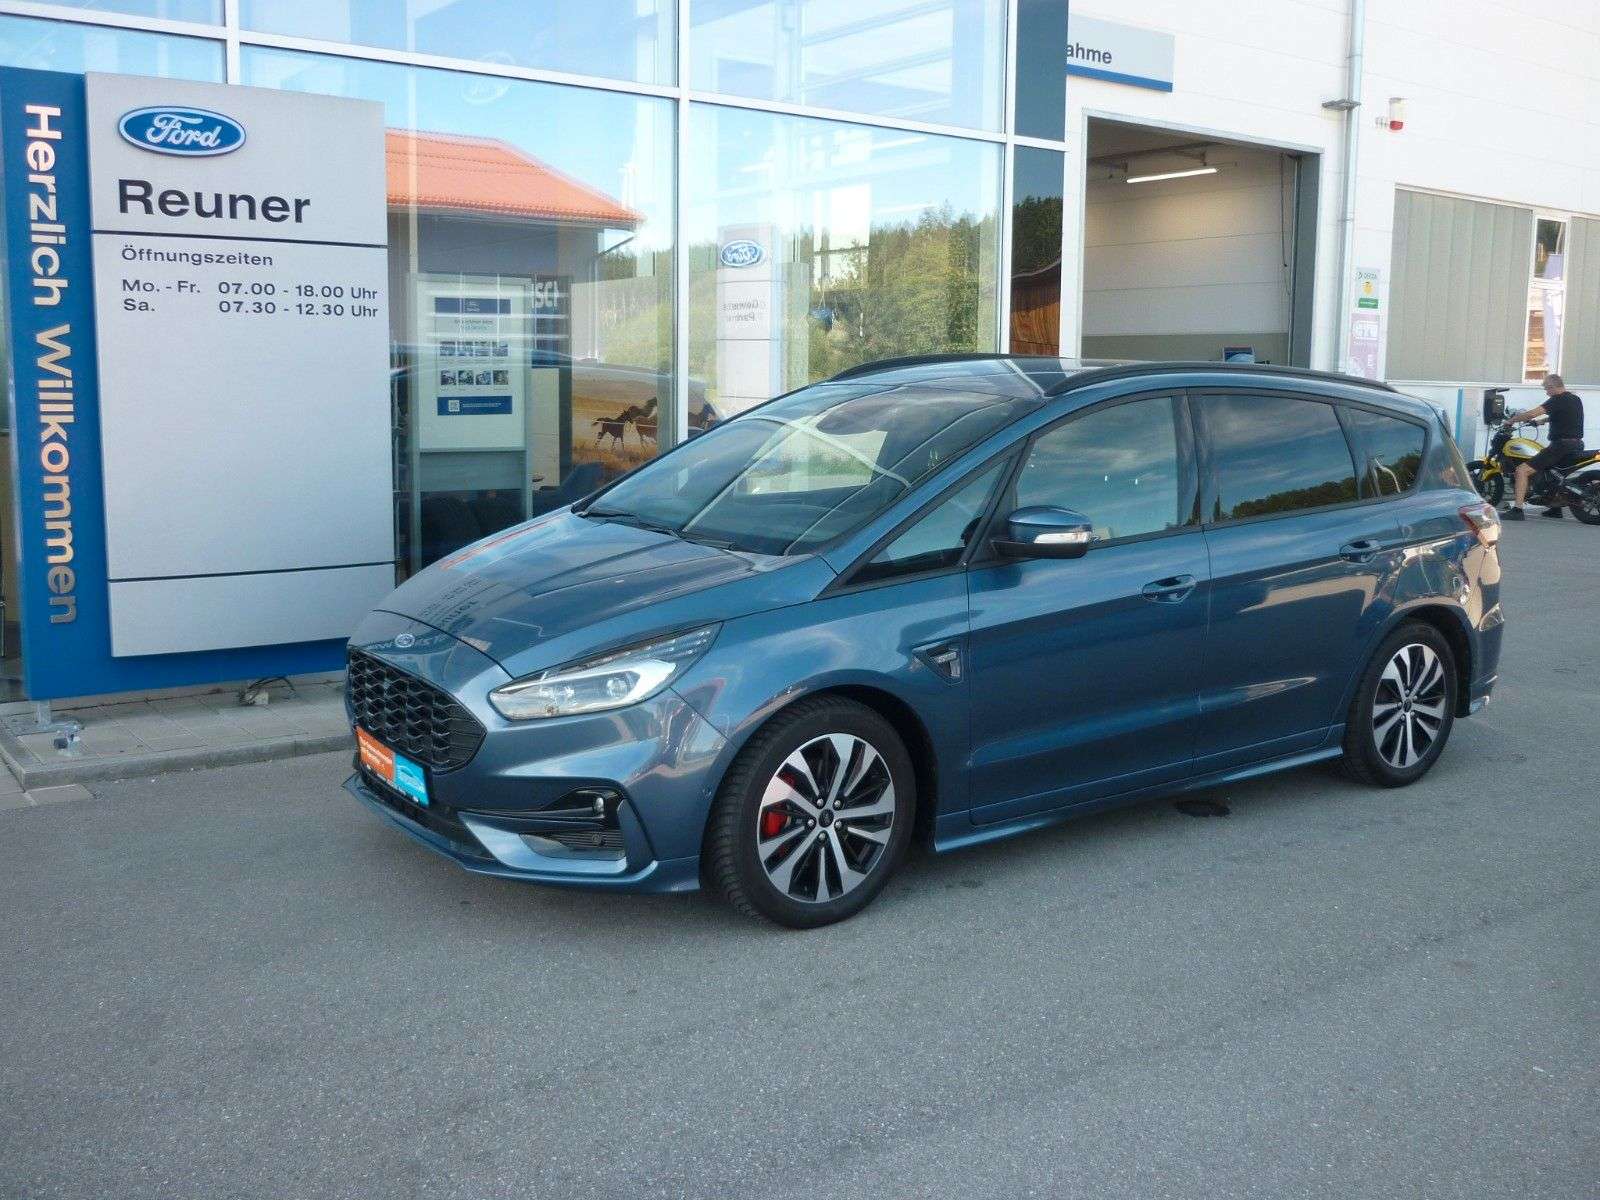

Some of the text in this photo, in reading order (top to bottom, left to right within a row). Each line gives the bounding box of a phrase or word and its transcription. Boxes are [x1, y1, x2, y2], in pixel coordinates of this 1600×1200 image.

[145, 113, 223, 148] Ford
[118, 178, 311, 224] Reuner
[121, 244, 273, 266] Öffnungszeiten
[122, 279, 161, 293] Mo.
[177, 280, 201, 294] Fr.
[218, 281, 276, 296] 07.00
[295, 285, 344, 299] 18.00
[350, 287, 378, 300] Uhr
[123, 299, 156, 312] Sa.
[218, 300, 276, 315] 07.30
[296, 303, 345, 317] 12.30
[351, 303, 379, 318] Uhr
[25, 104, 77, 624] Herzlich Willkommen
